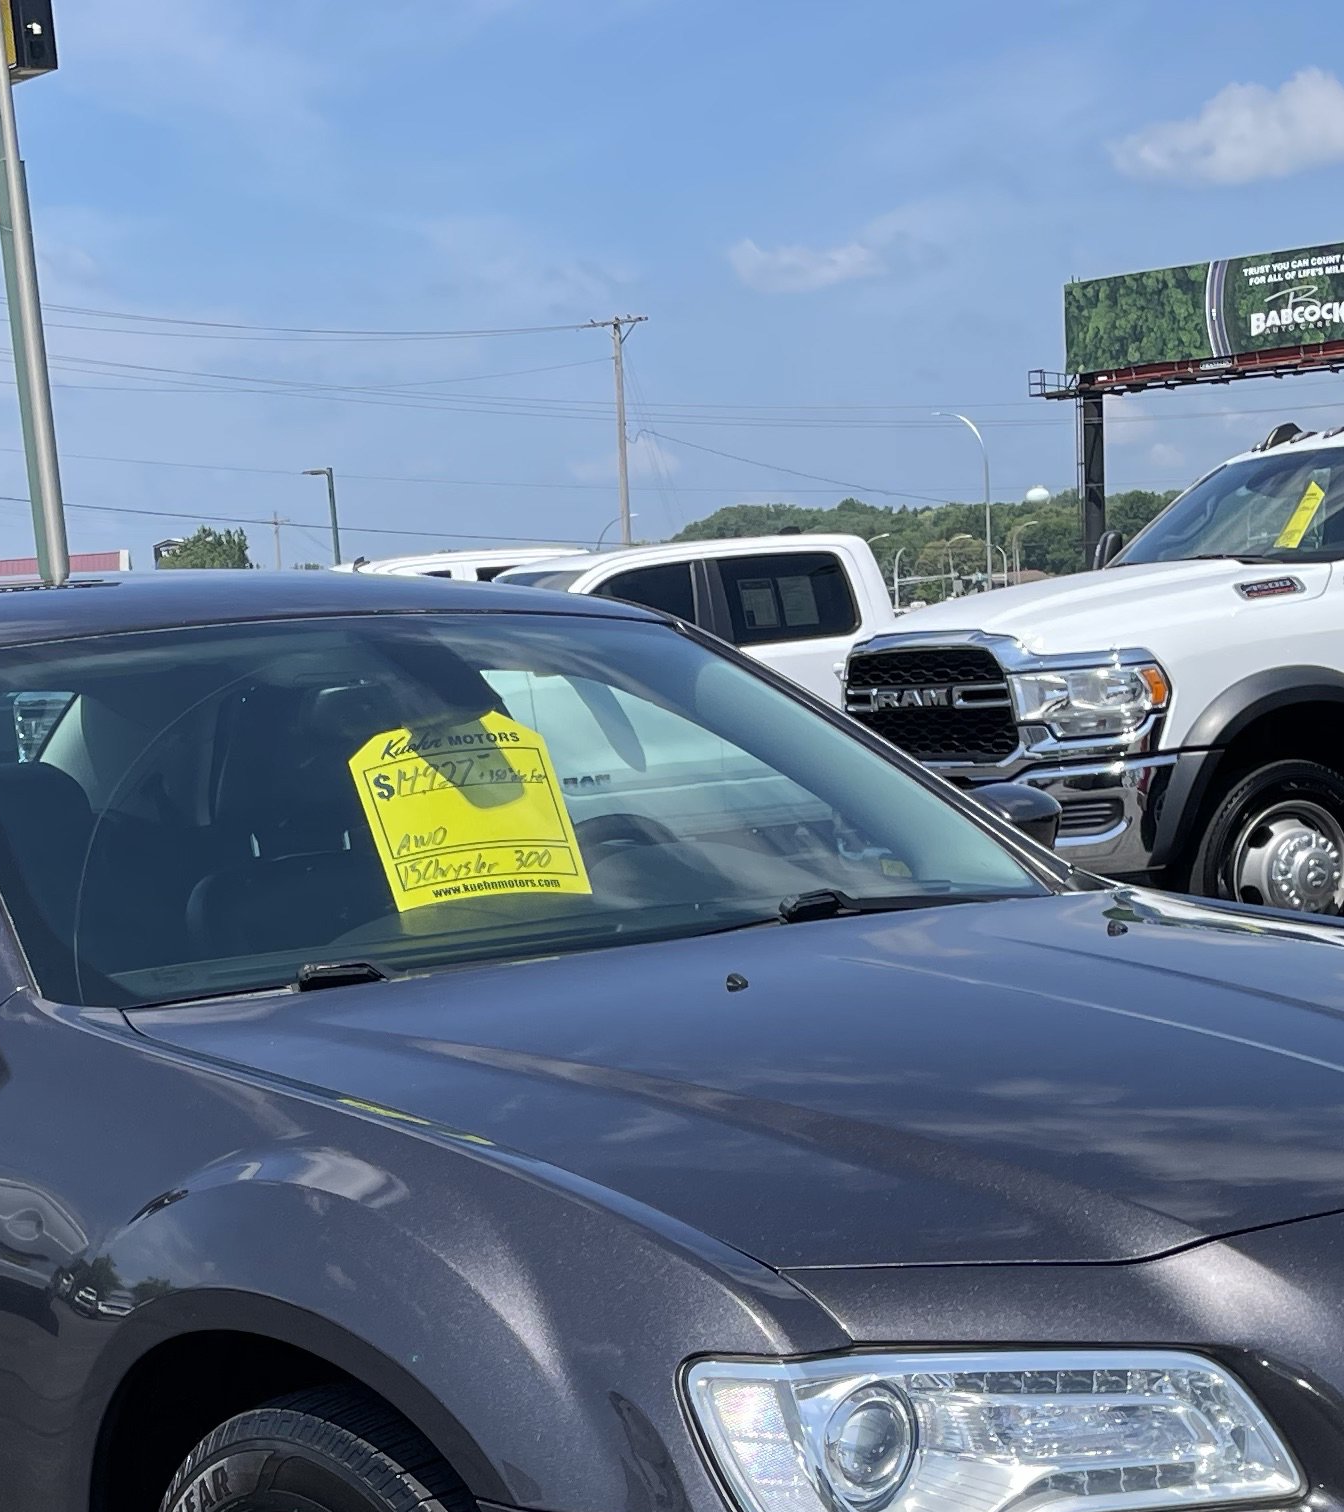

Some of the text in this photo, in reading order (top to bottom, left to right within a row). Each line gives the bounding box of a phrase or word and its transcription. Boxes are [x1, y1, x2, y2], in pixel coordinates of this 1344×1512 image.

[1242, 264, 1271, 277] TRUST
[1272, 261, 1290, 271] YOU
[1291, 258, 1309, 269] CAN
[1311, 254, 1341, 266] COUNT
[1249, 276, 1267, 286] FOR
[1267, 273, 1284, 283] ALL
[1284, 271, 1297, 281] OF
[1264, 320, 1331, 335] AUTO CARE
[877, 688, 949, 708] RAM
[447, 732, 521, 747] MOTORS
[514, 849, 552, 872] 300
[431, 877, 562, 899] www.kuehnmotors.com
